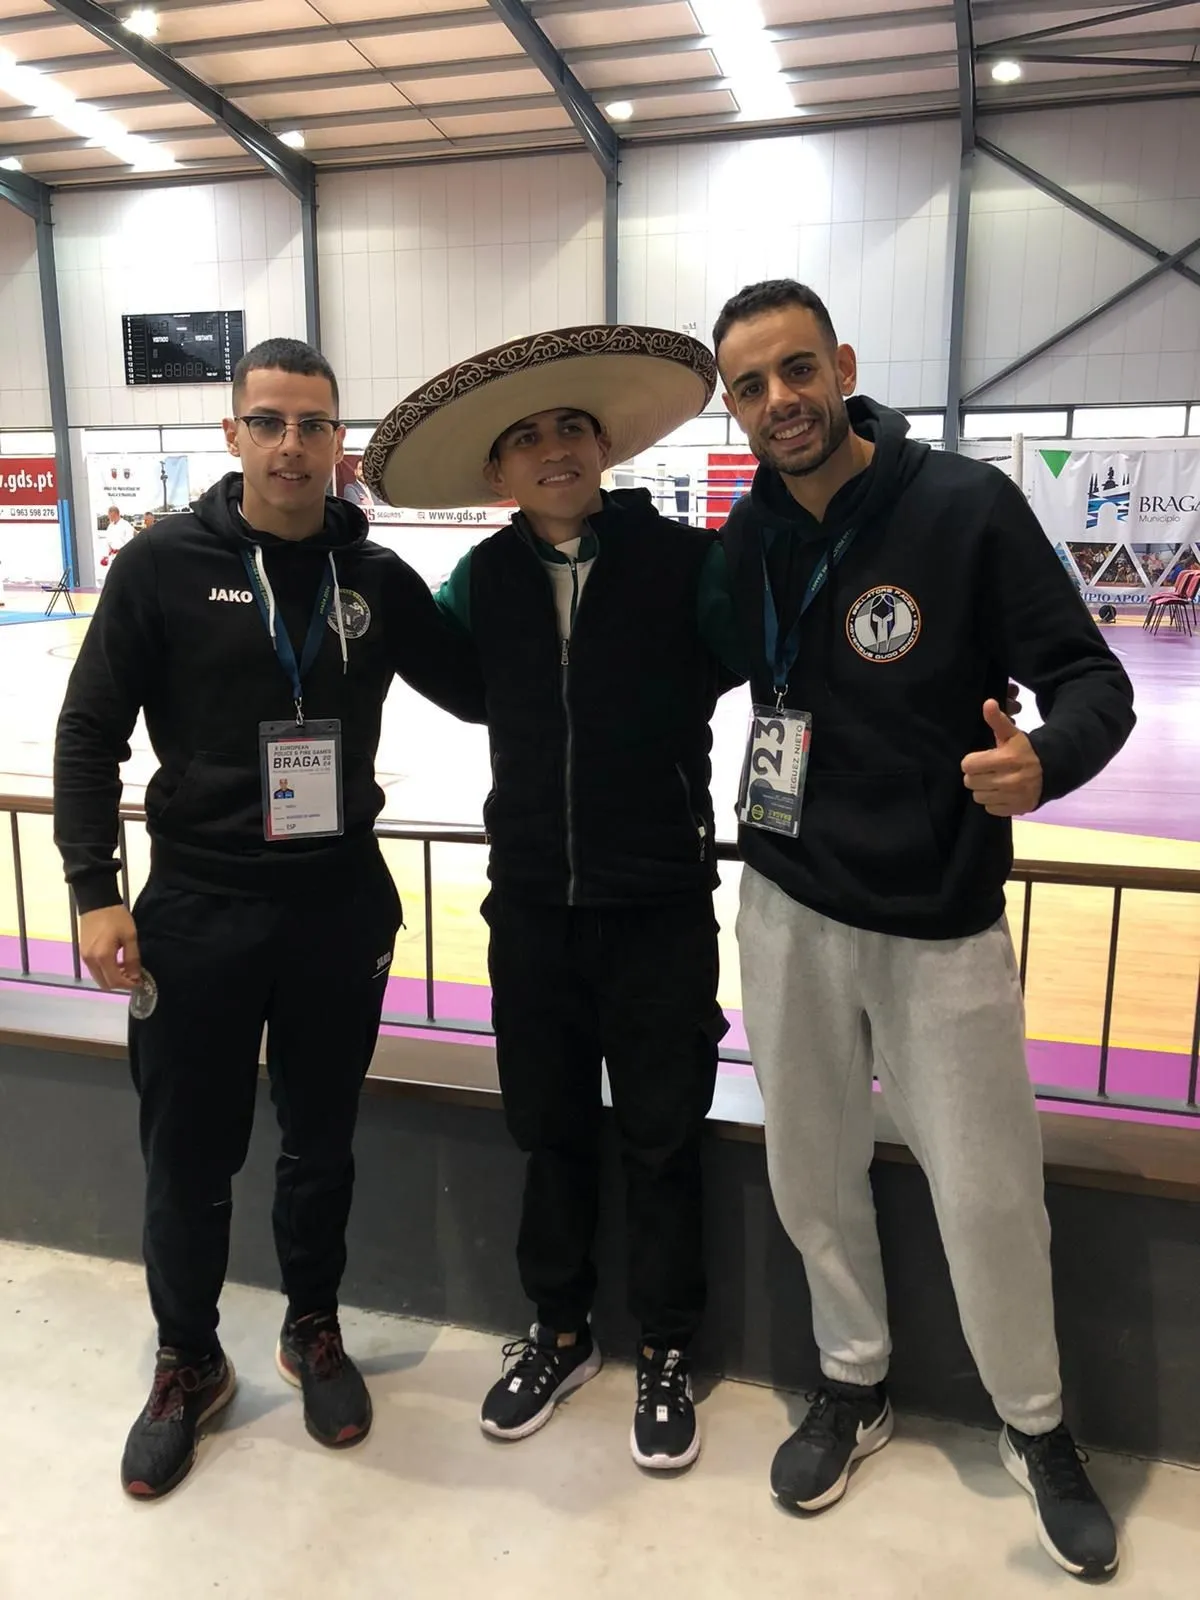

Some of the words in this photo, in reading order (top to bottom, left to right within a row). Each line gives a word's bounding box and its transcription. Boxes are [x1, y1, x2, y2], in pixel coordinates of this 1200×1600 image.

[16, 508, 28, 516] 963
[29, 508, 41, 516] 598
[43, 508, 55, 517] 276
[428, 511, 487, 523] www.gds.pt
[208, 587, 253, 604] JAKO
[1082, 592, 1111, 602] IPIO
[1115, 594, 1150, 602] APOI
[794, 725, 803, 754] NIETO
[273, 755, 320, 768] BRAGA
[790, 758, 800, 795] IEGUEZ
